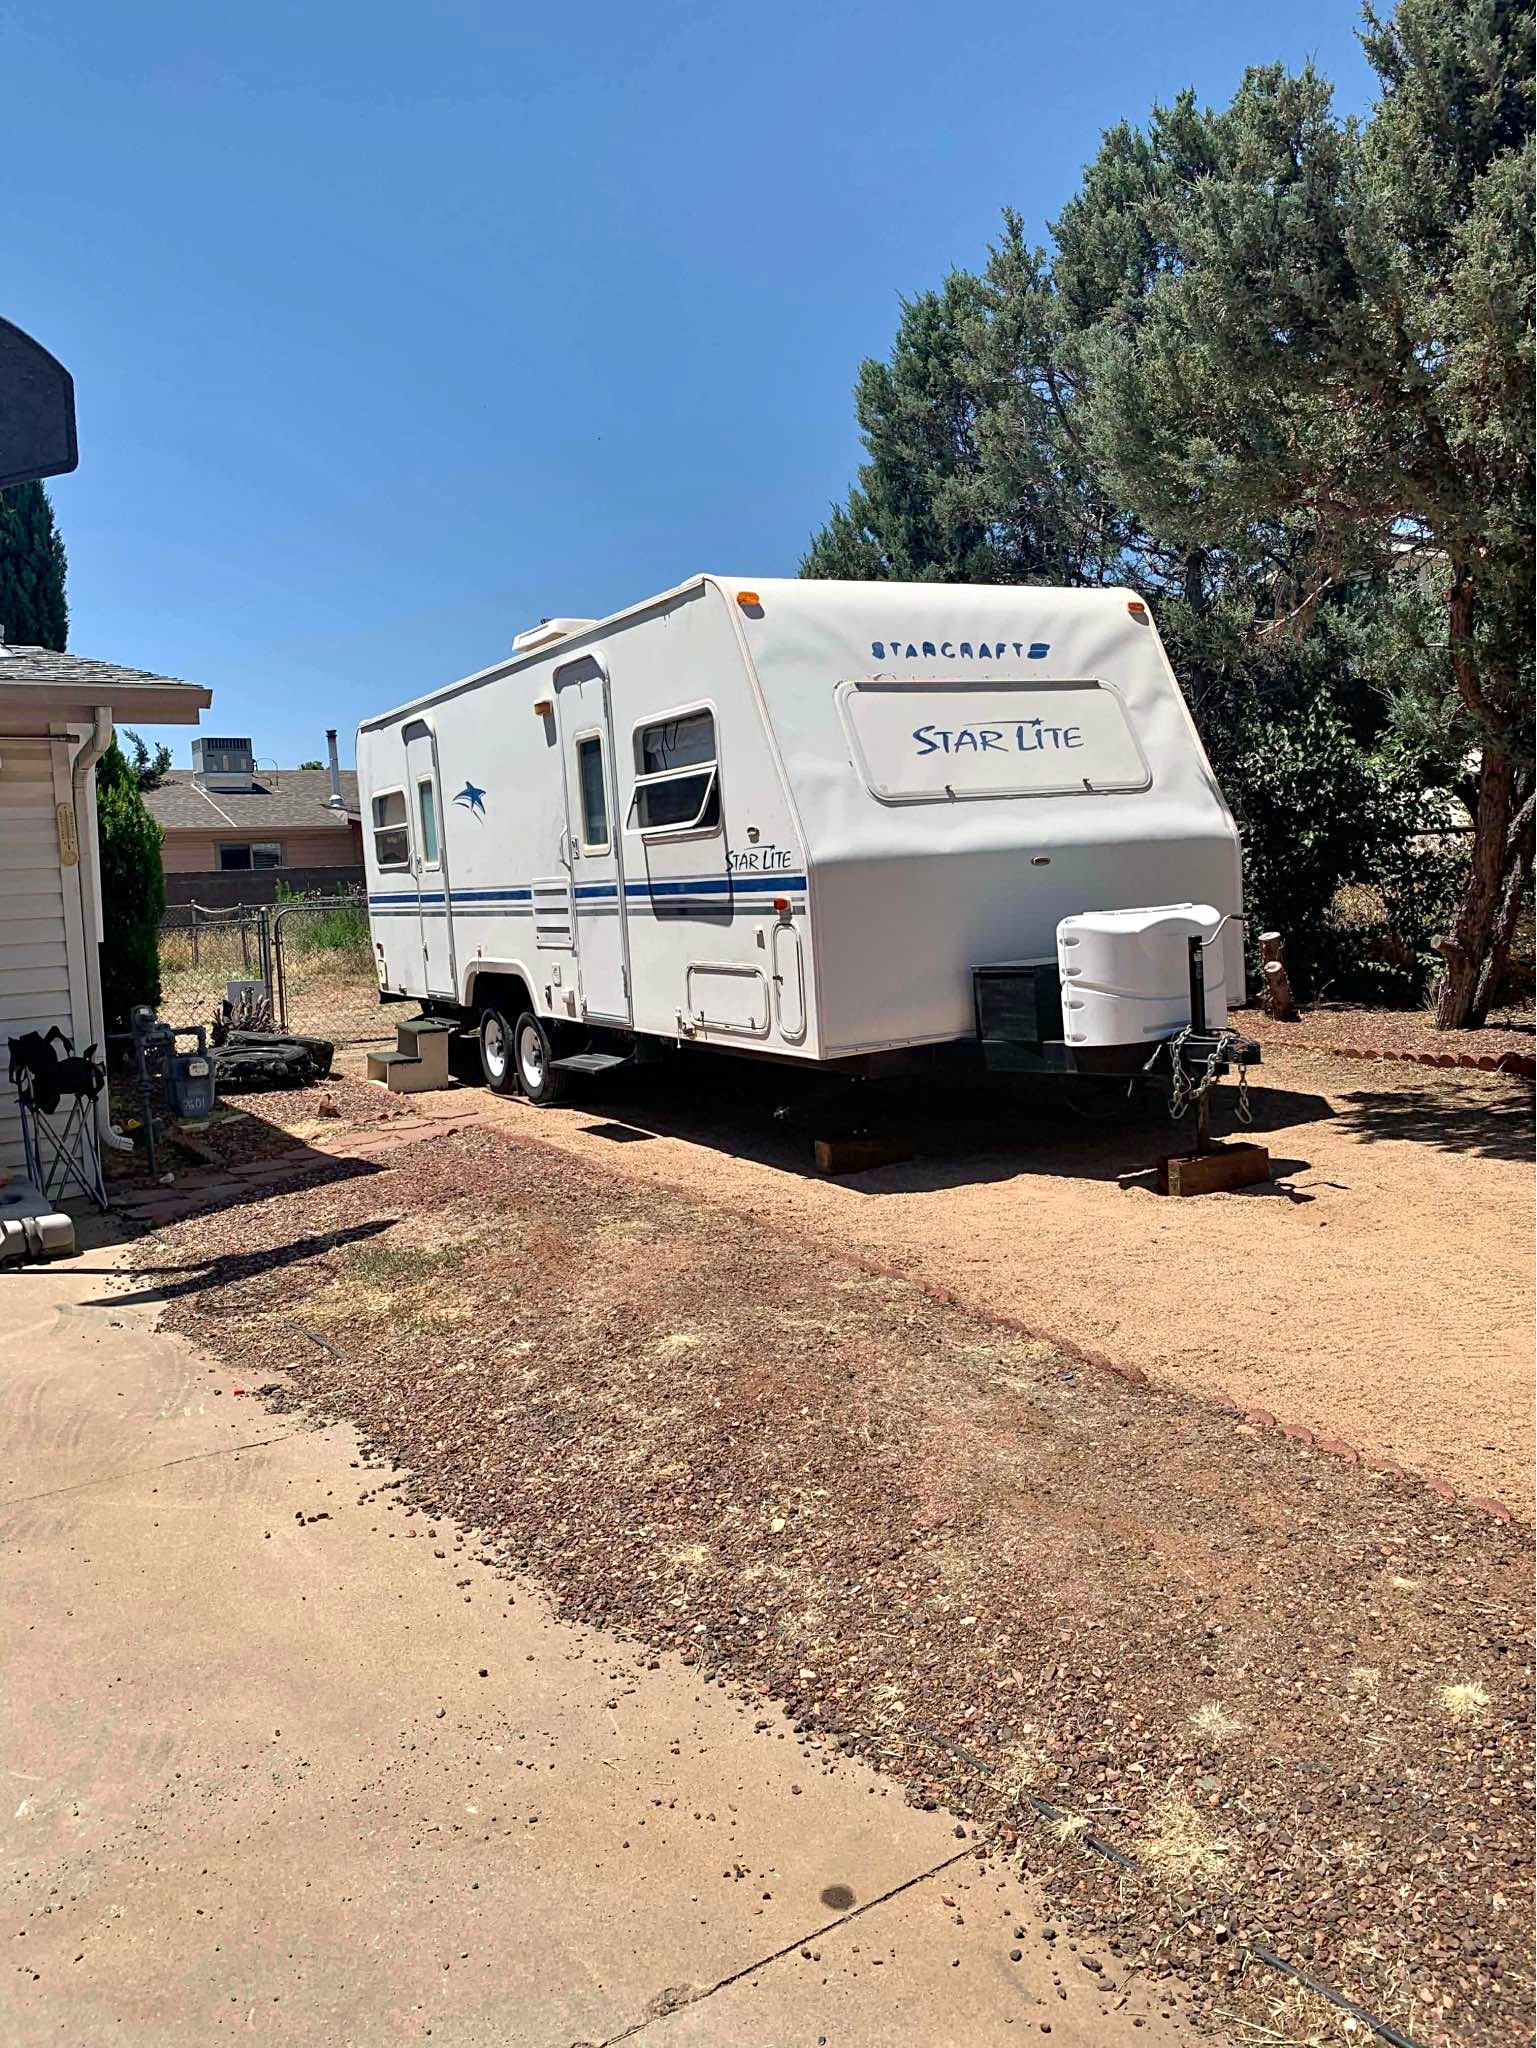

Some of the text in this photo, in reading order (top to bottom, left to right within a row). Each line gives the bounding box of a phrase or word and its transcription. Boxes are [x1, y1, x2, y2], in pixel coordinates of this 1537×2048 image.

[871, 641, 1024, 660] STARCRAFT
[912, 725, 1008, 755] STAR
[725, 850, 759, 872] STAR
